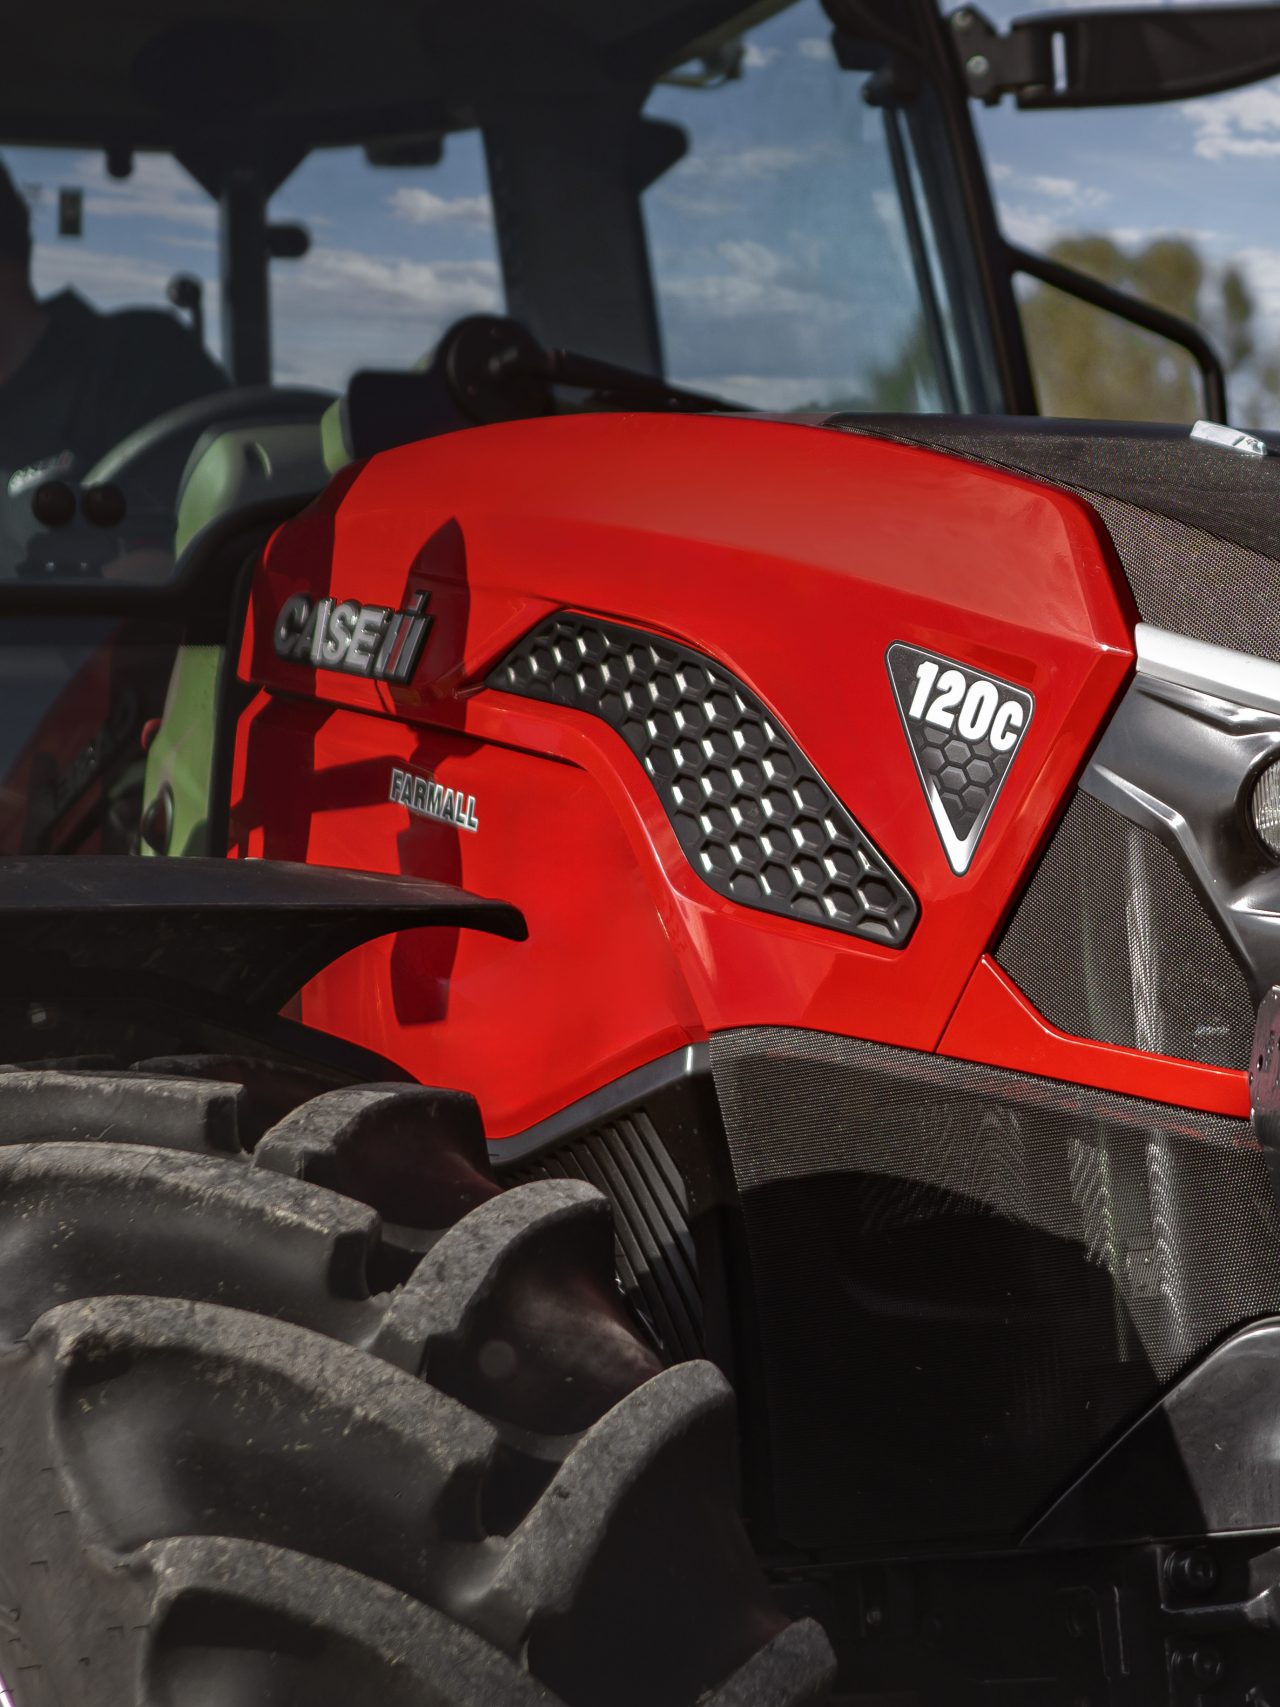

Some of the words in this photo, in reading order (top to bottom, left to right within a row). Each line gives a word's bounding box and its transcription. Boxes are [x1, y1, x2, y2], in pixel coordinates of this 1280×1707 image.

[274, 593, 394, 676] CASE
[909, 661, 1023, 751] 120C
[389, 767, 479, 832] FARMALL
